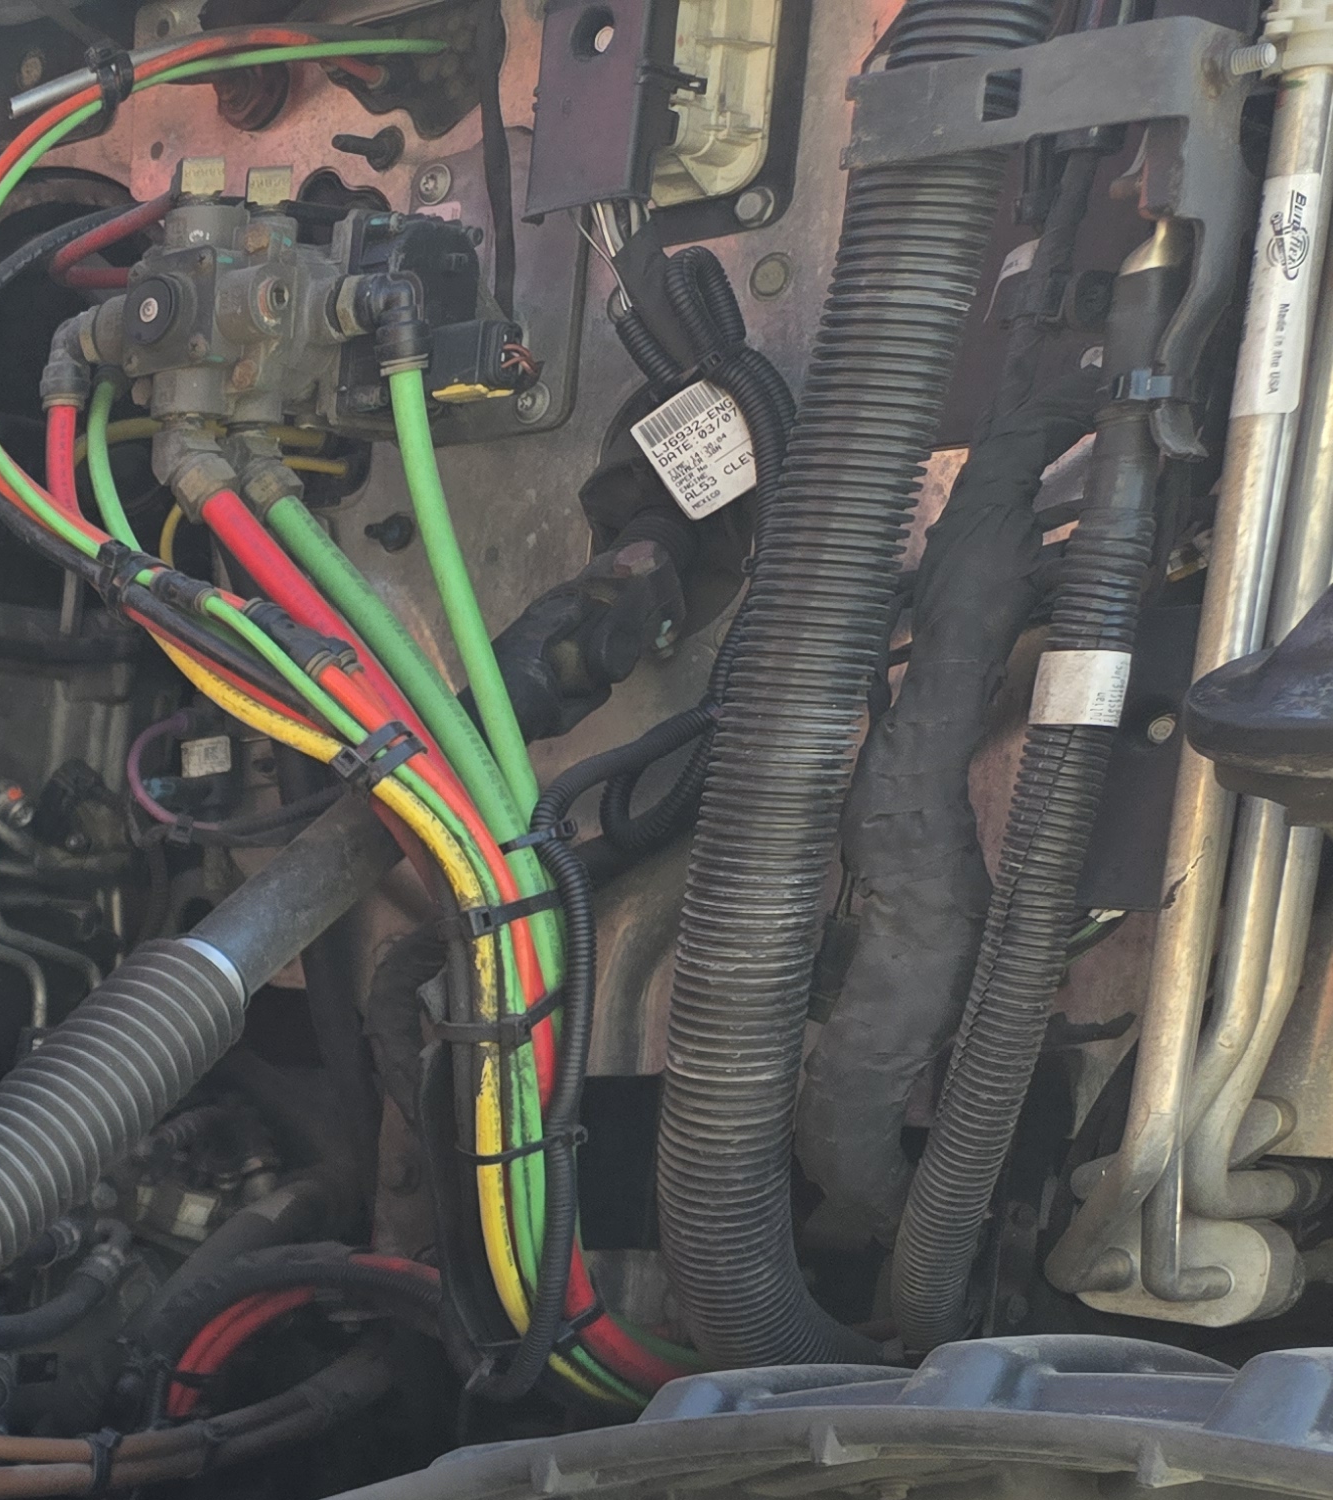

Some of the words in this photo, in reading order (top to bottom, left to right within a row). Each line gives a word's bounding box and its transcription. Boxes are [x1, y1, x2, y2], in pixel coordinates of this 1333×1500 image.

[1276, 302, 1290, 332] Made
[1270, 351, 1283, 370] the
[1266, 370, 1282, 396] USA
[652, 398, 733, 459] LJ6932-ENG
[679, 473, 708, 493] ENGINE
[684, 475, 717, 502] AL53
[692, 489, 720, 510] MEXICO
